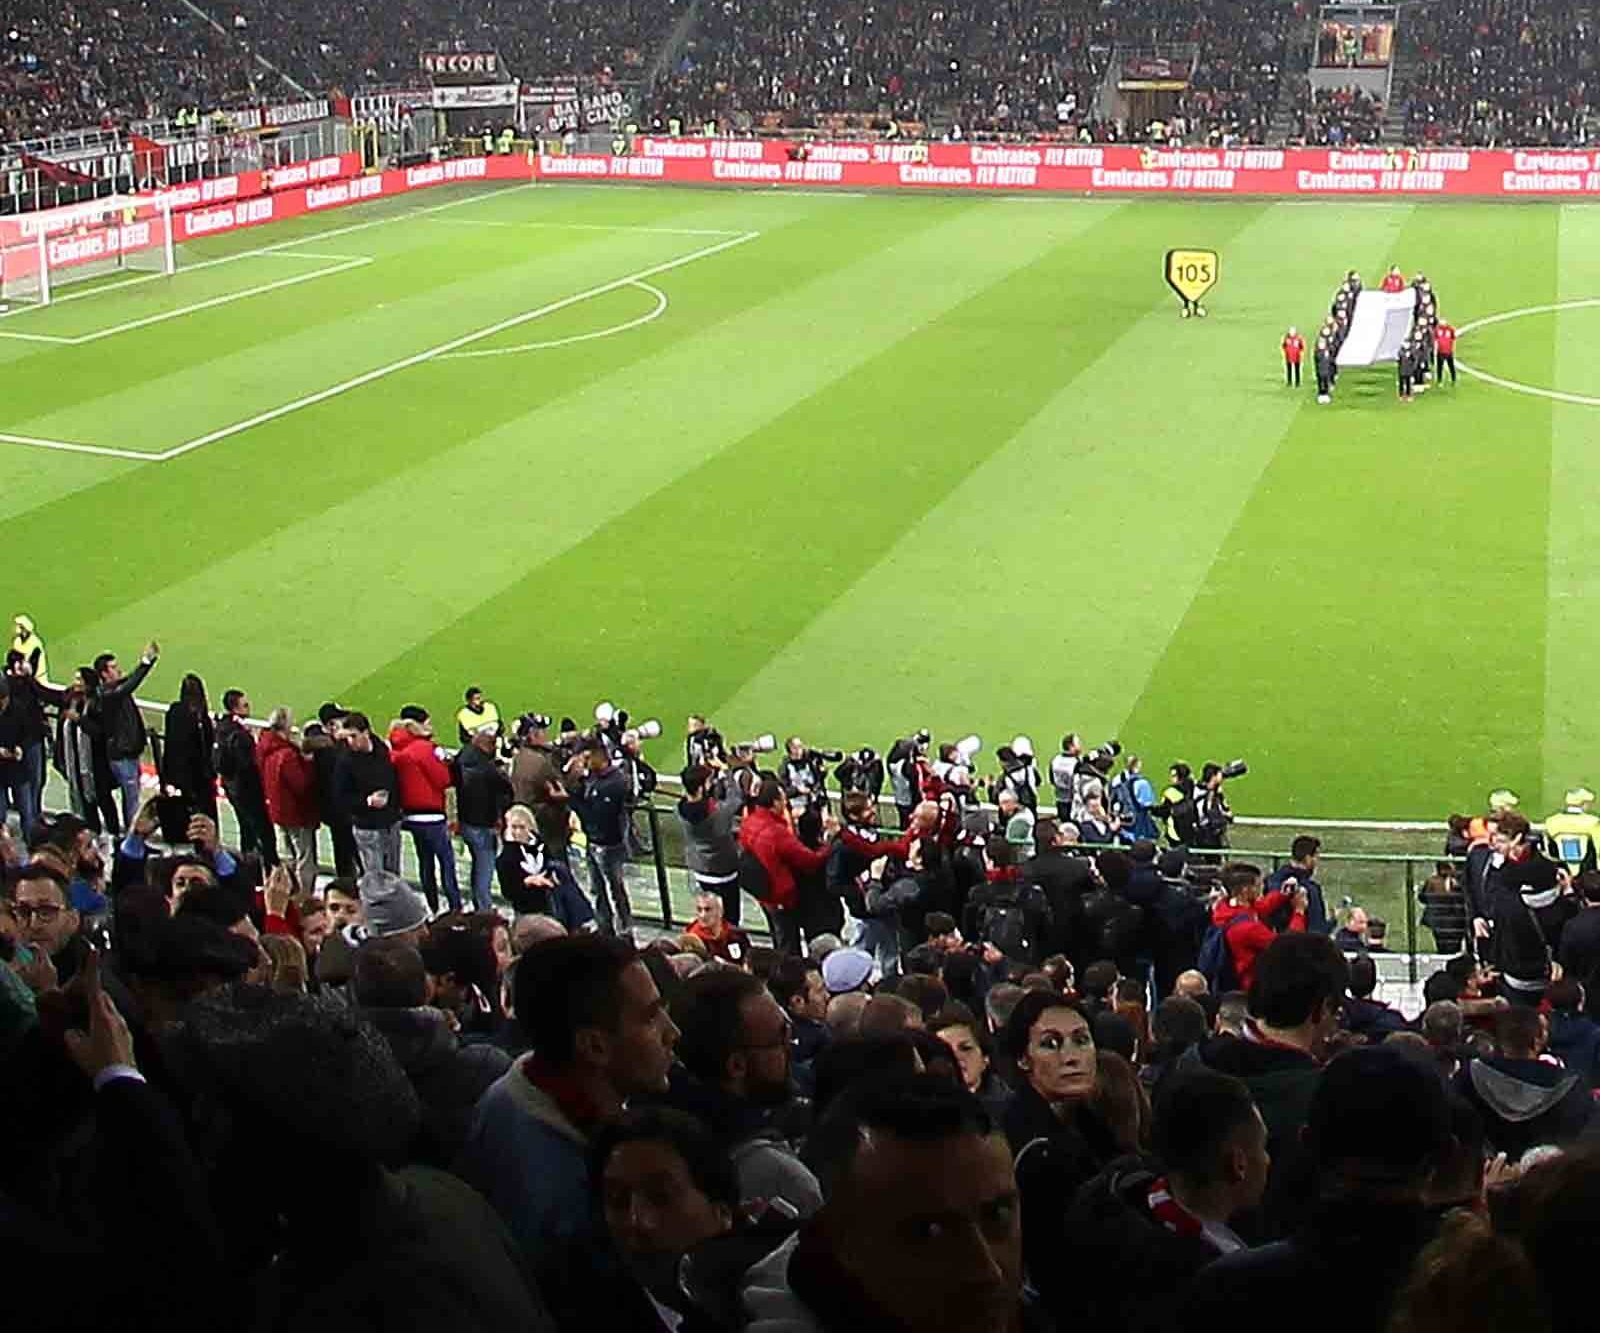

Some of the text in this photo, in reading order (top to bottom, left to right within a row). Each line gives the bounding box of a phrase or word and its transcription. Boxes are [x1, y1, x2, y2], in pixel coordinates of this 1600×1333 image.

[643, 139, 706, 158] Emirates
[971, 145, 1041, 164] Emirates
[1150, 149, 1219, 167] Emirates
[540, 156, 607, 175] Emirates
[712, 160, 782, 179] Emirates
[1514, 152, 1589, 170] Emirates
[899, 165, 972, 183] Emirates
[1092, 168, 1168, 187] Emirates
[1297, 170, 1376, 189] Emirates
[1503, 171, 1581, 190] Emirates
[1176, 264, 1211, 283] 105
